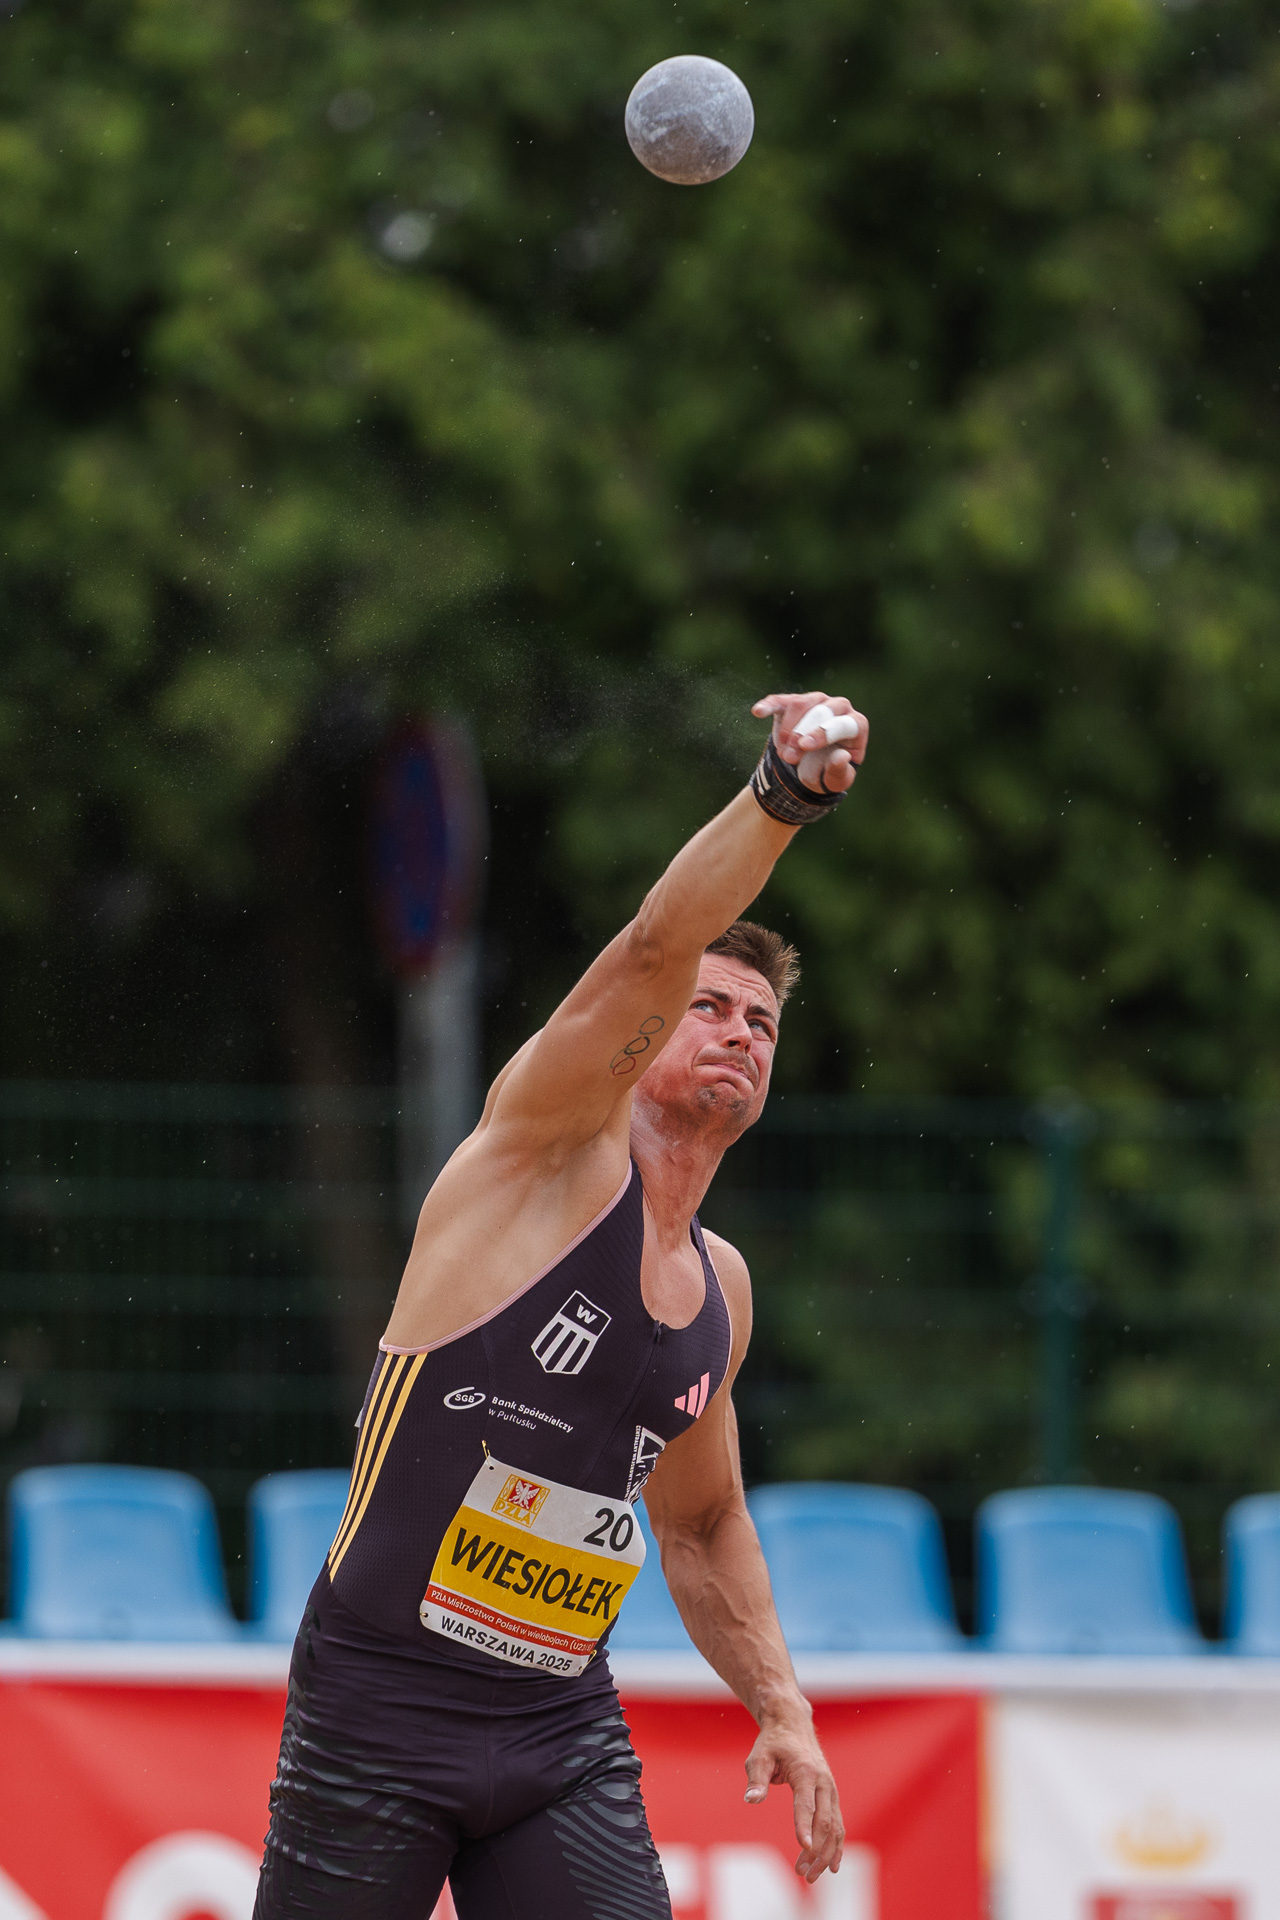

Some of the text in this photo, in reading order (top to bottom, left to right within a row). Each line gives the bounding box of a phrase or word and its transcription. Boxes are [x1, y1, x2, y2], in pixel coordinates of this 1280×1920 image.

[576, 1304, 598, 1325] W
[454, 1394, 475, 1404] SGB
[491, 1396, 574, 1434] Bank Spółdzielczy
[488, 1408, 537, 1430] w Pułtusku
[495, 1500, 531, 1525] PZLA
[583, 1507, 634, 1552] 20
[450, 1527, 624, 1620] WIESIOŁEK
[431, 1590, 447, 1602] PZLA
[447, 1596, 495, 1623] Mistrzostwa
[495, 1618, 520, 1633] Polski
[520, 1627, 528, 1635] w
[527, 1629, 569, 1647] wielobojach
[441, 1615, 573, 1672] WARSZAWA 2025
